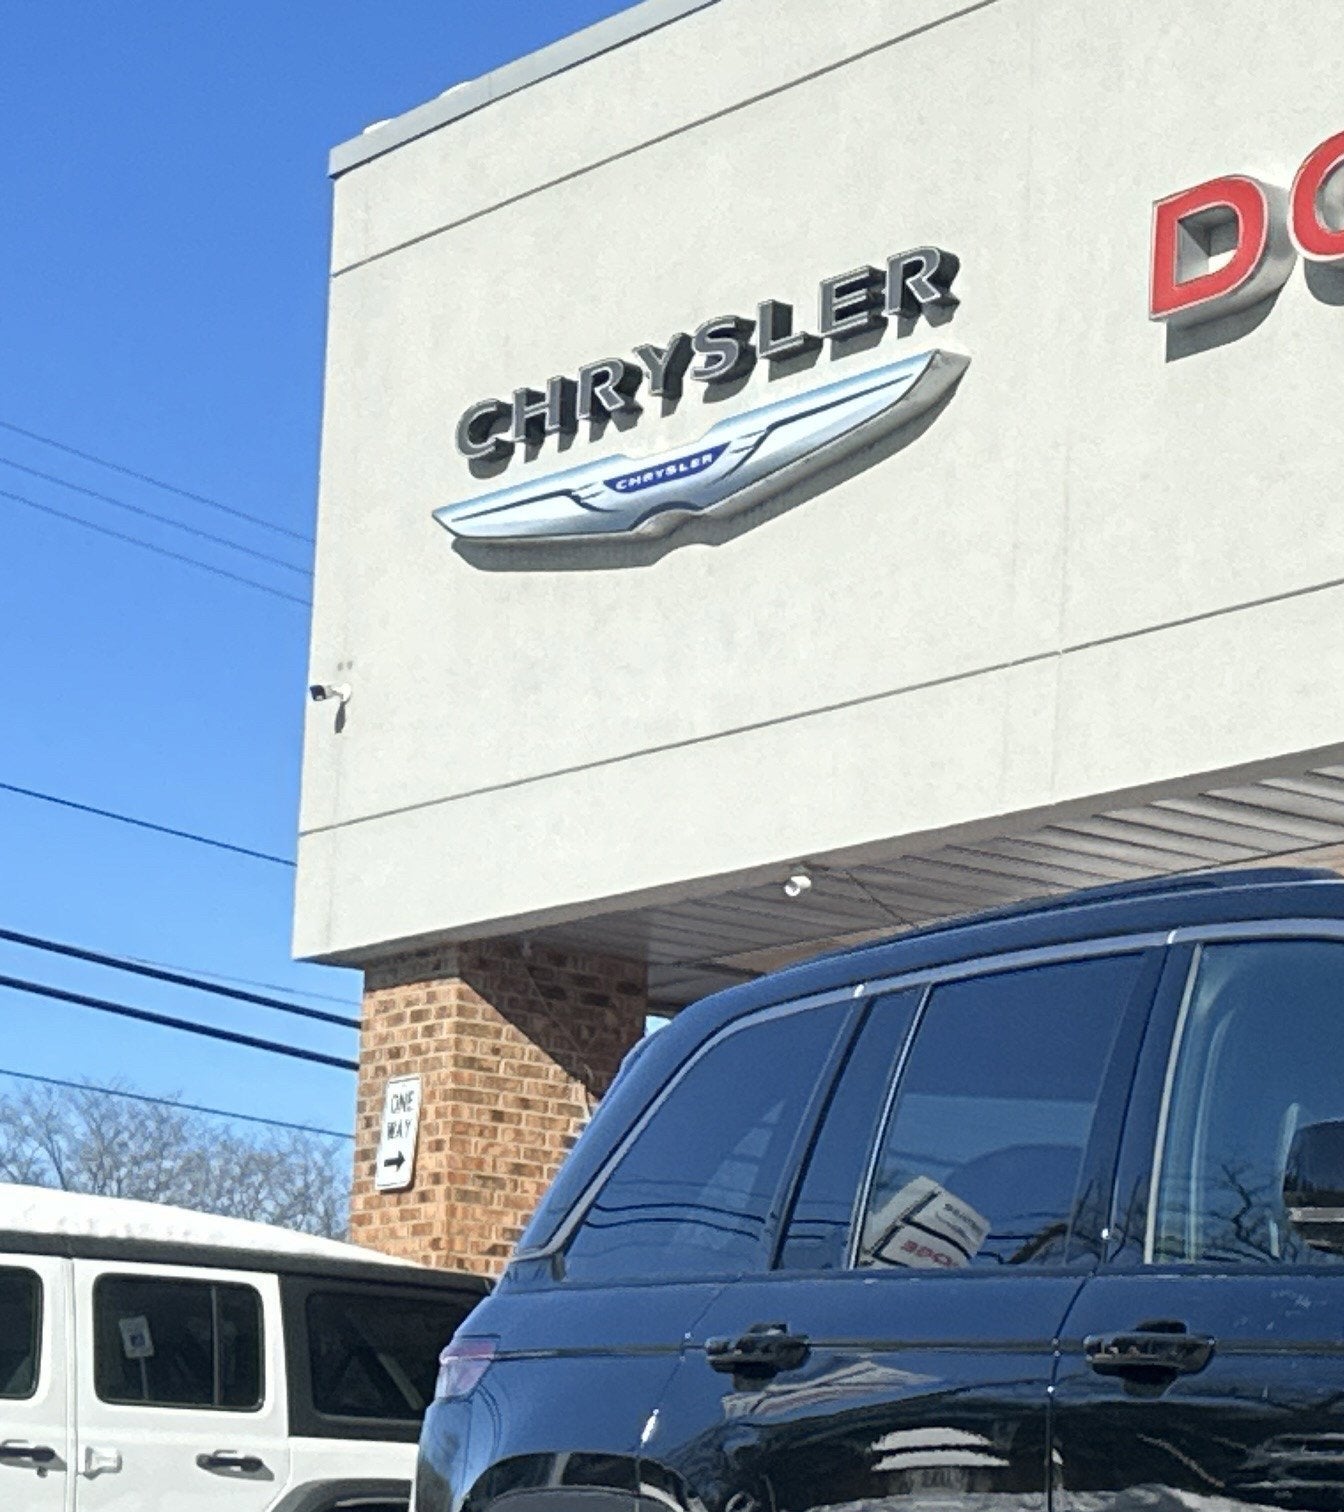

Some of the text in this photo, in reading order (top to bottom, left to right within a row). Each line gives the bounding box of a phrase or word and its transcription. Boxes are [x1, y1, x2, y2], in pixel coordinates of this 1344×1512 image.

[454, 246, 959, 461] CHRYSLER
[615, 453, 713, 490] CHRYSLER
[390, 1090, 415, 1114] ONE
[387, 1119, 412, 1140] WAY
